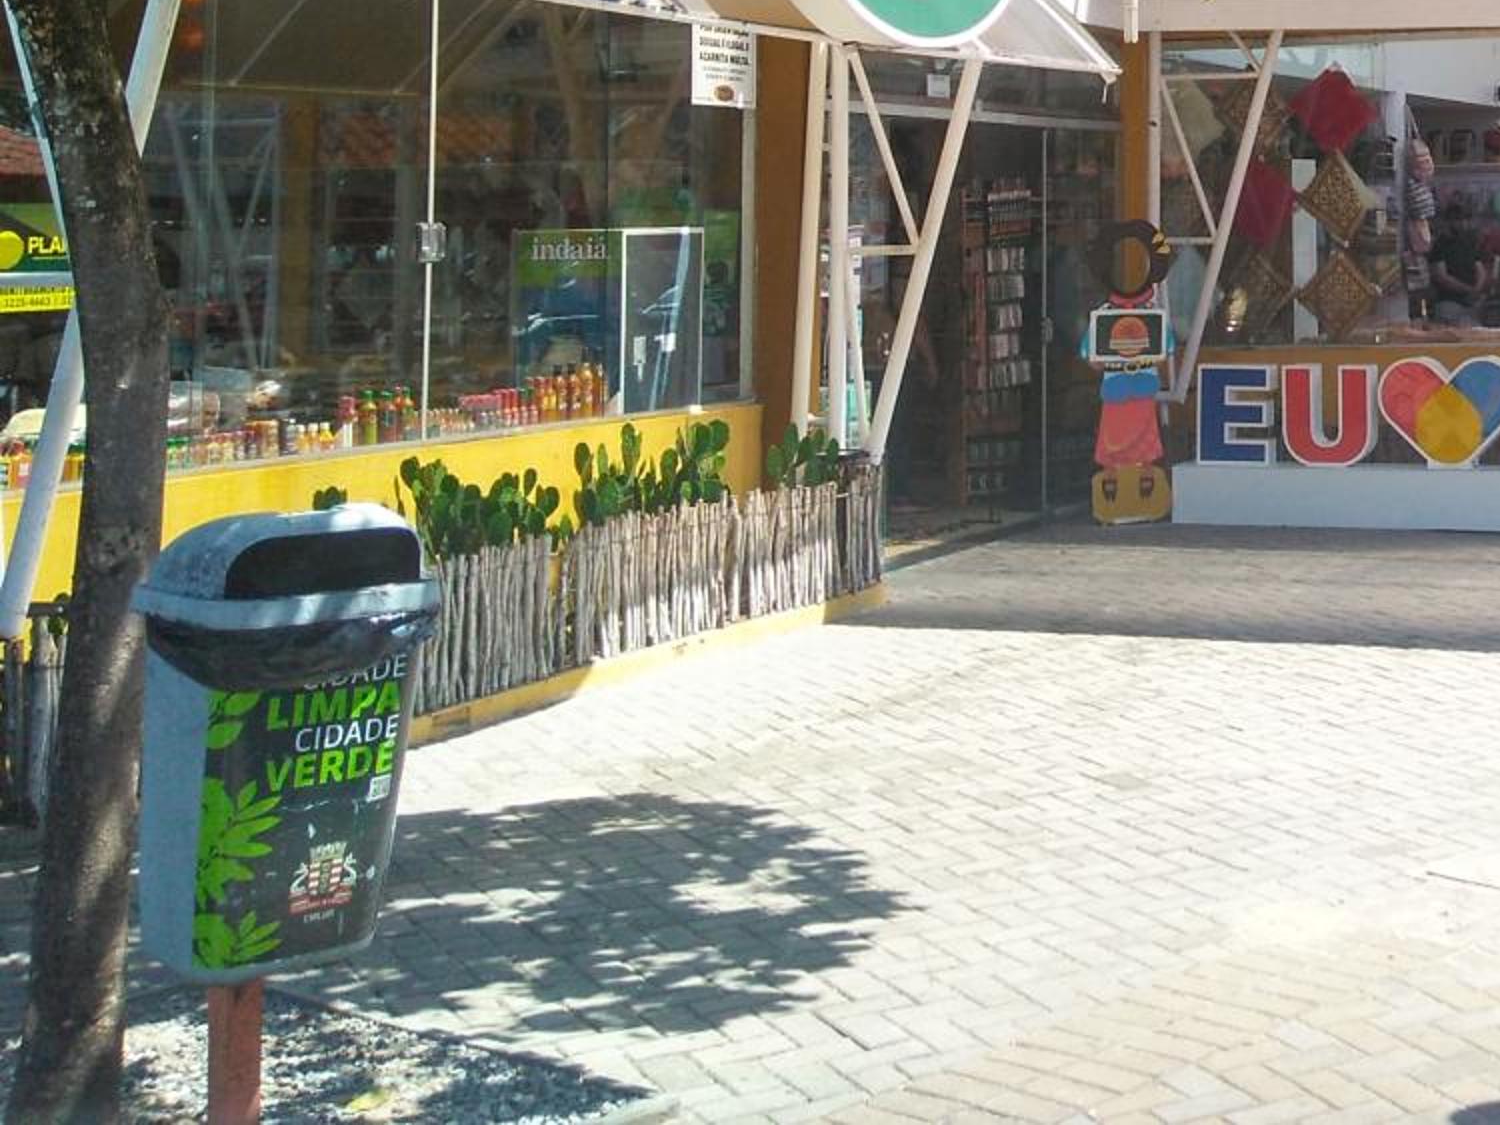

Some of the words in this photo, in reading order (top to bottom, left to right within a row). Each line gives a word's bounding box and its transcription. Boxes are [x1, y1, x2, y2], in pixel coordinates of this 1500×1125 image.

[28, 236, 66, 254] PLA
[531, 236, 607, 261] indaiá
[1198, 364, 1377, 467] EU
[304, 654, 408, 690] DADE
[266, 681, 401, 731] LIMPA
[295, 714, 400, 753] CIDADE
[266, 739, 396, 793] VERDE
